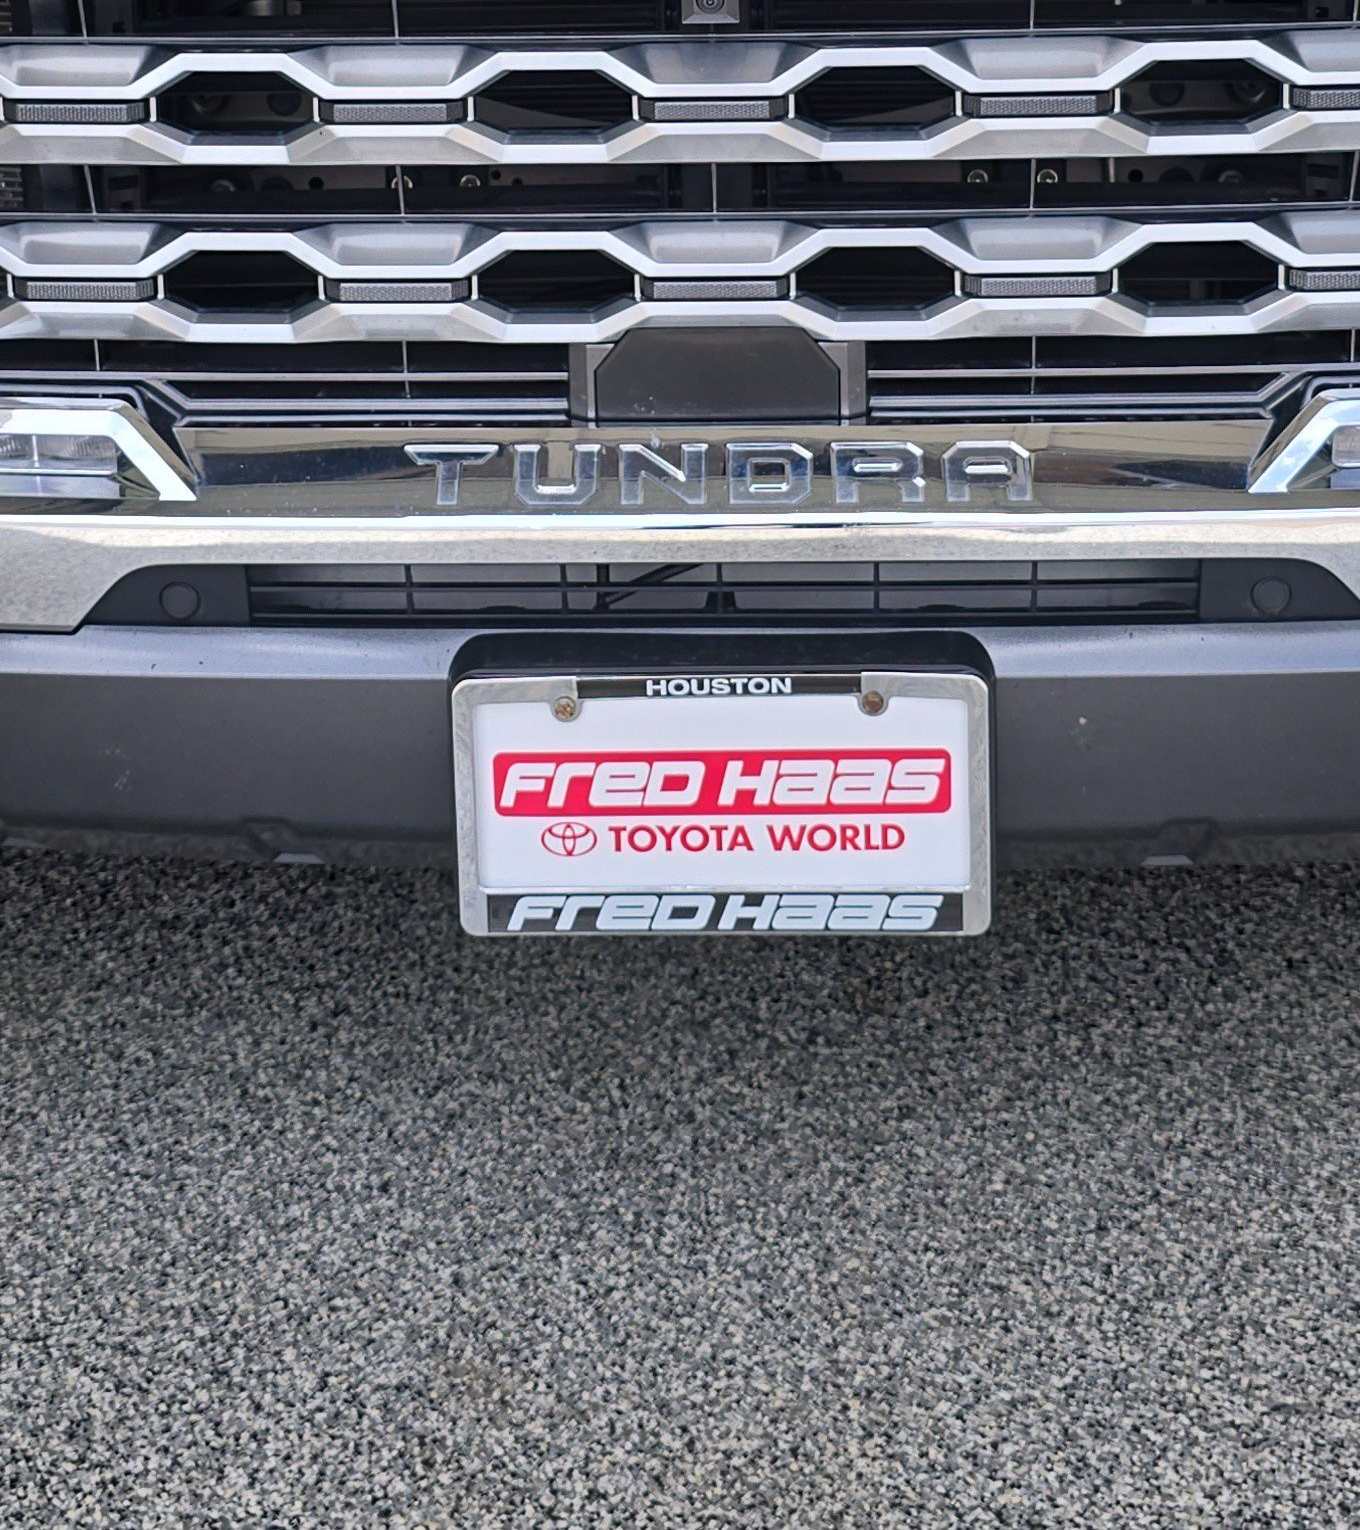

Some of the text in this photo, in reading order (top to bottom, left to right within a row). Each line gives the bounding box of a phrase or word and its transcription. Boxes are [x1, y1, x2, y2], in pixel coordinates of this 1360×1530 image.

[404, 441, 1035, 505] TUNDRA
[646, 677, 792, 696] HOUSTON
[608, 822, 906, 852] TOYOTA WORLD
